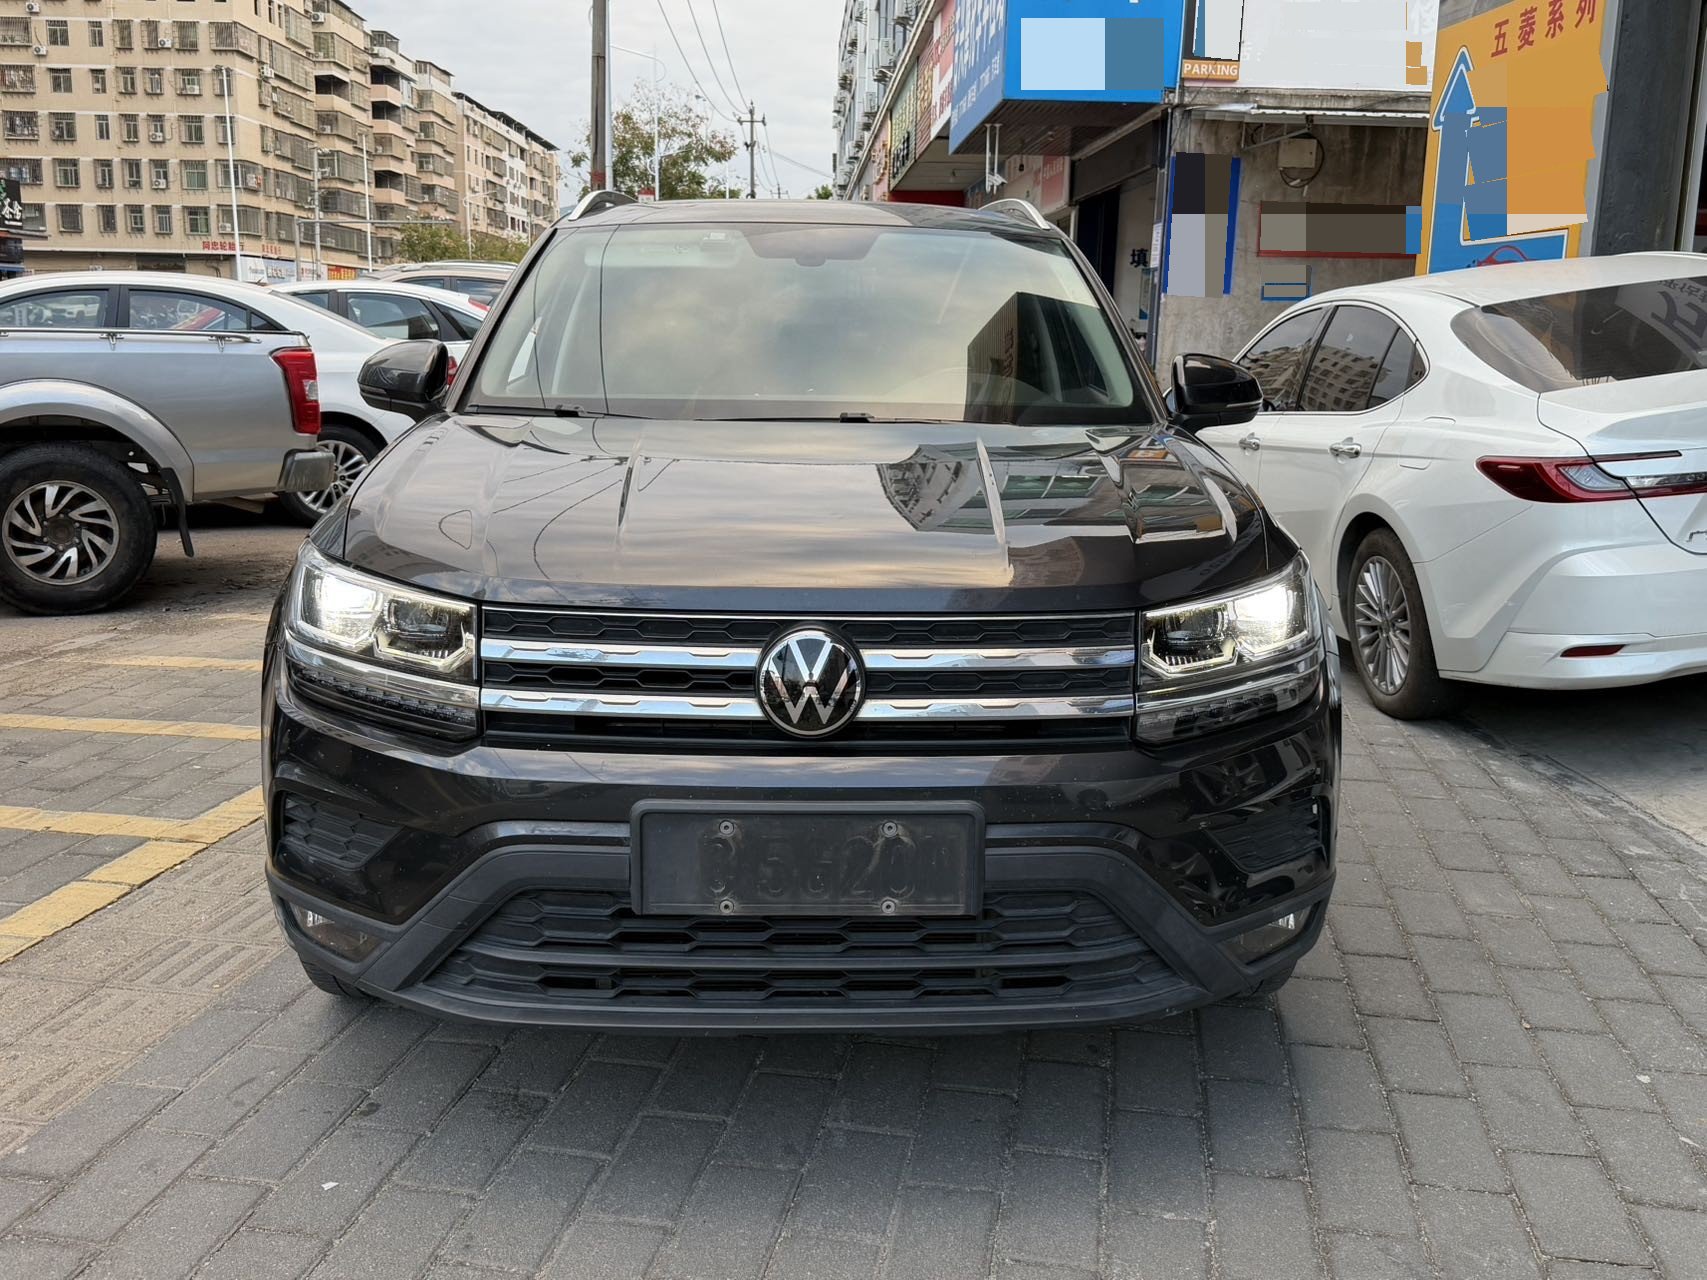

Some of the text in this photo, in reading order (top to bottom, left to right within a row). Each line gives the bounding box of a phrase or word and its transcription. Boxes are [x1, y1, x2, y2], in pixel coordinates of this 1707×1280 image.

[1490, 0, 1597, 57] 五菱系列
[1184, 62, 1238, 77] PARKING
